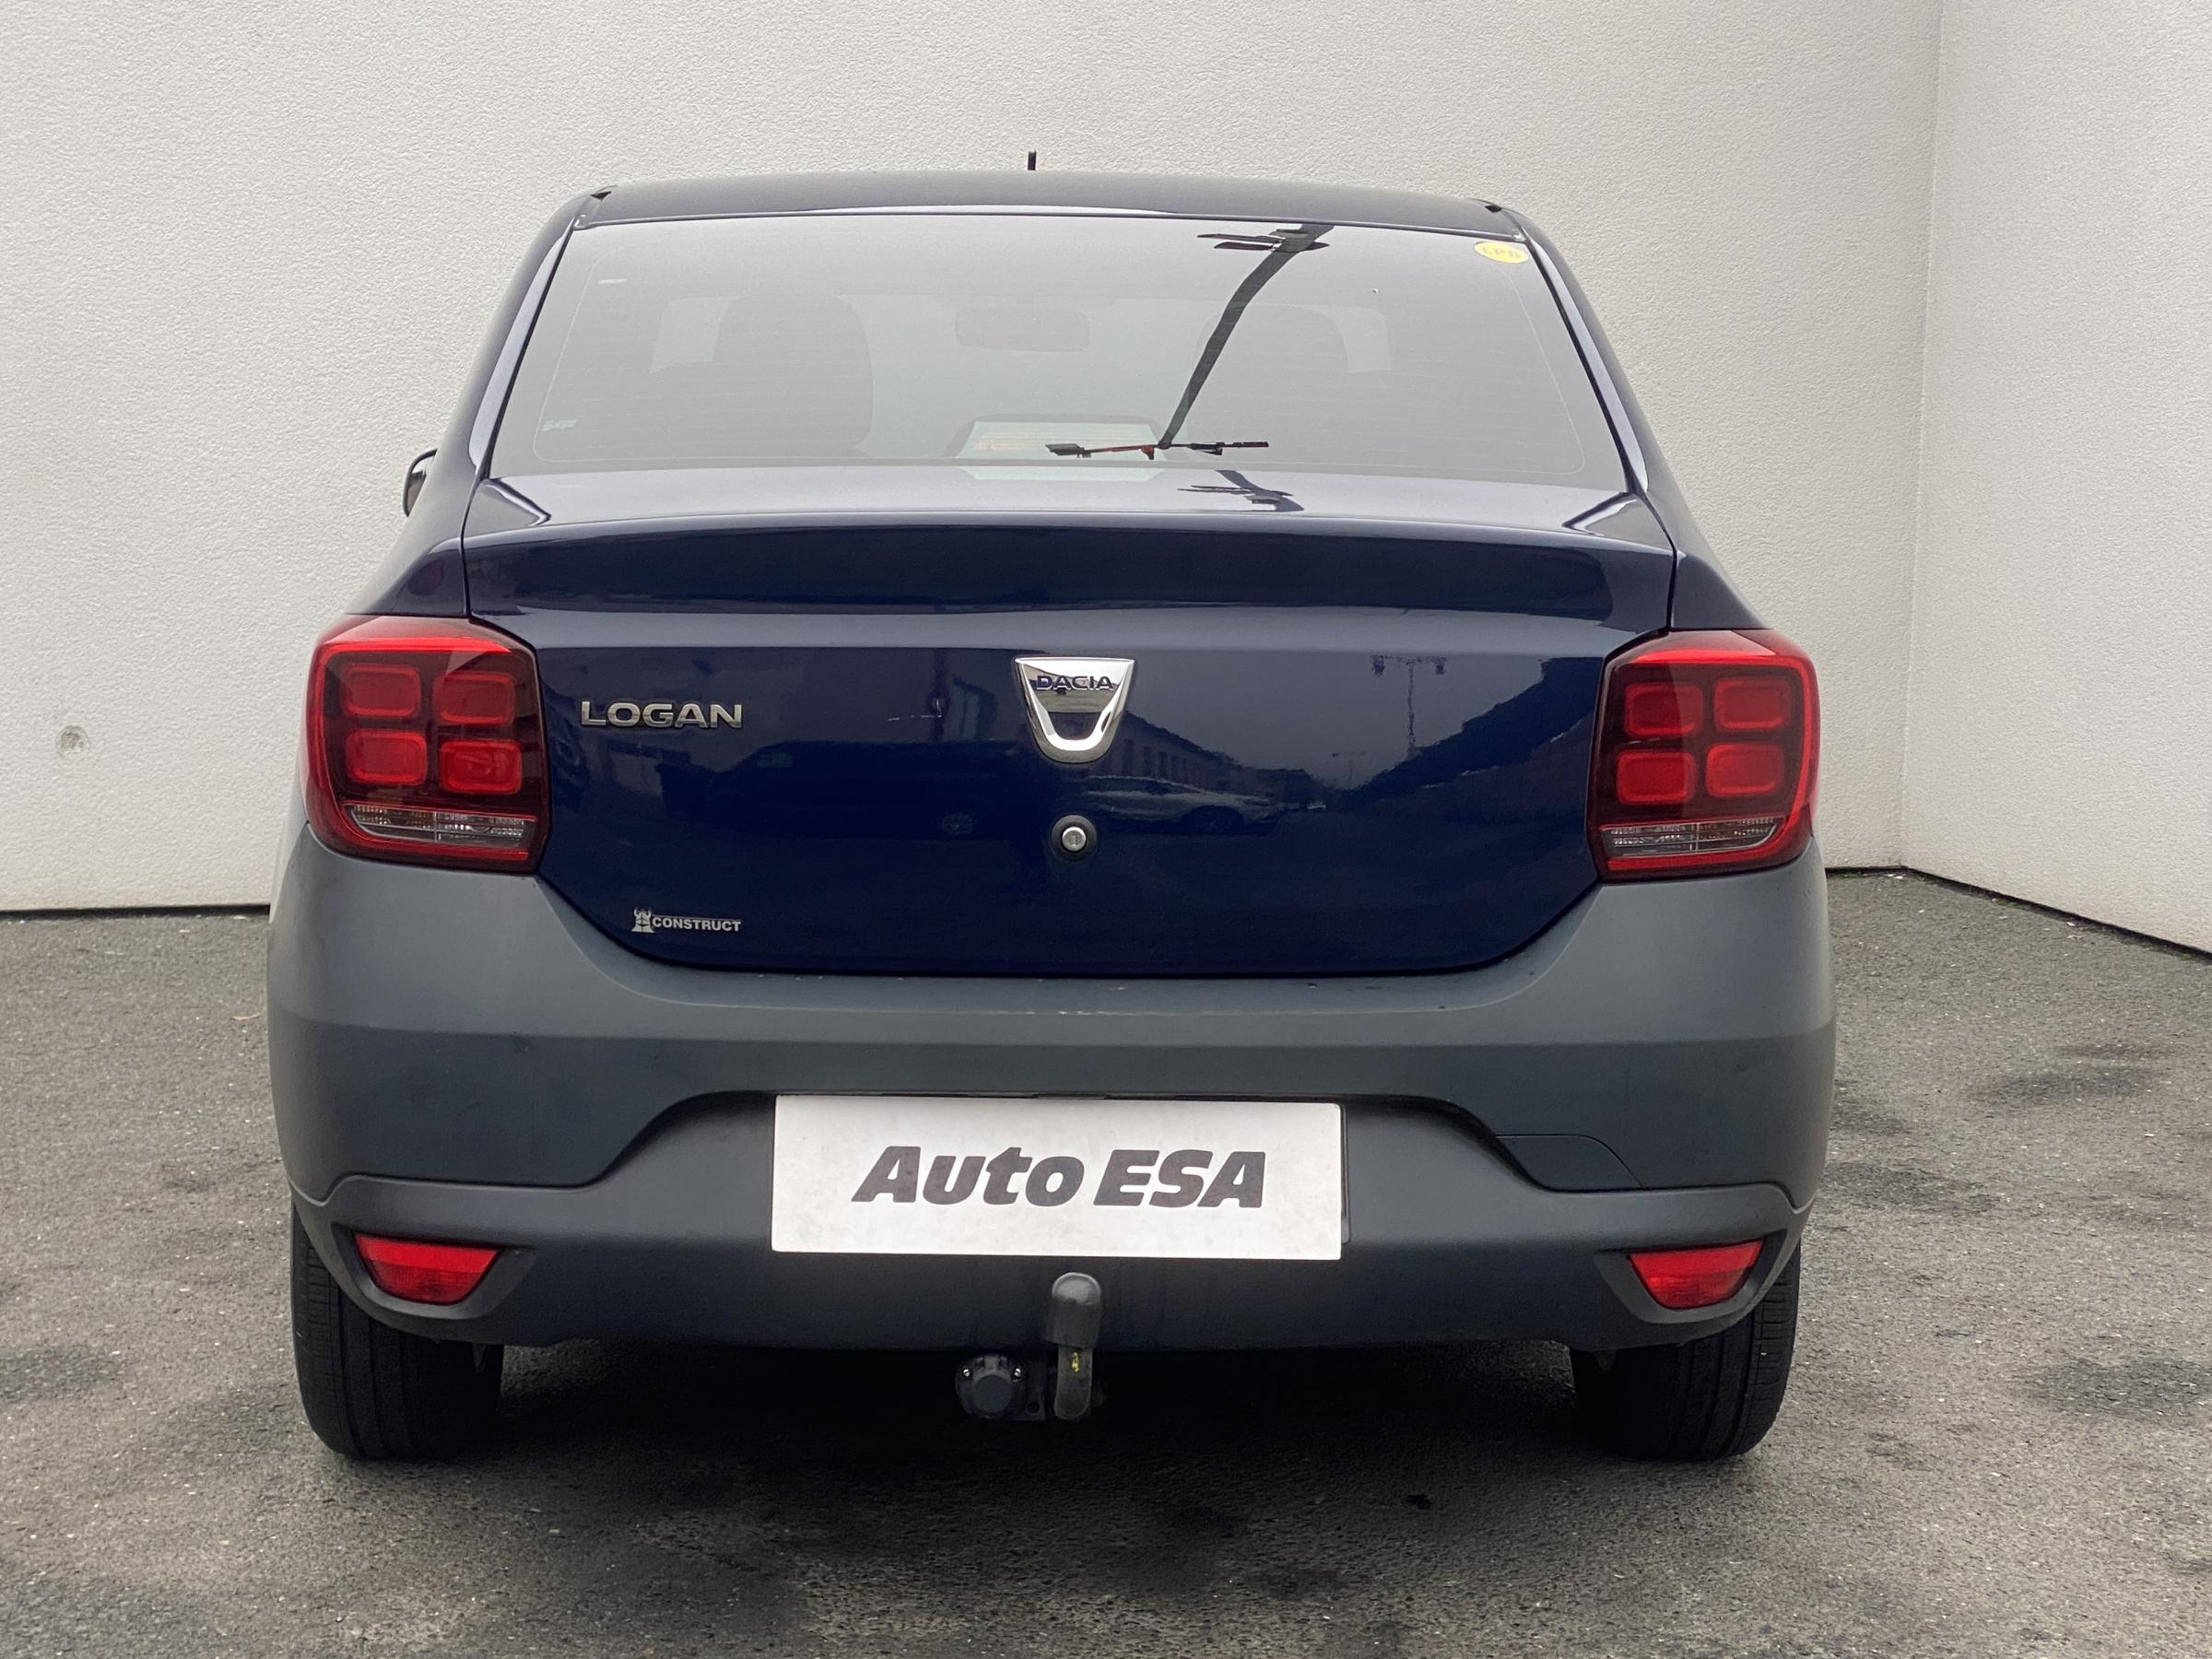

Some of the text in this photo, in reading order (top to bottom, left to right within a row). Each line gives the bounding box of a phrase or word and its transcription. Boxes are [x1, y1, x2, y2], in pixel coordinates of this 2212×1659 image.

[1036, 675, 1114, 690] DACIA
[581, 700, 743, 728] LOGAN
[652, 917, 741, 932] CONSTRUCT
[851, 1146, 1266, 1209] Auto ESA
